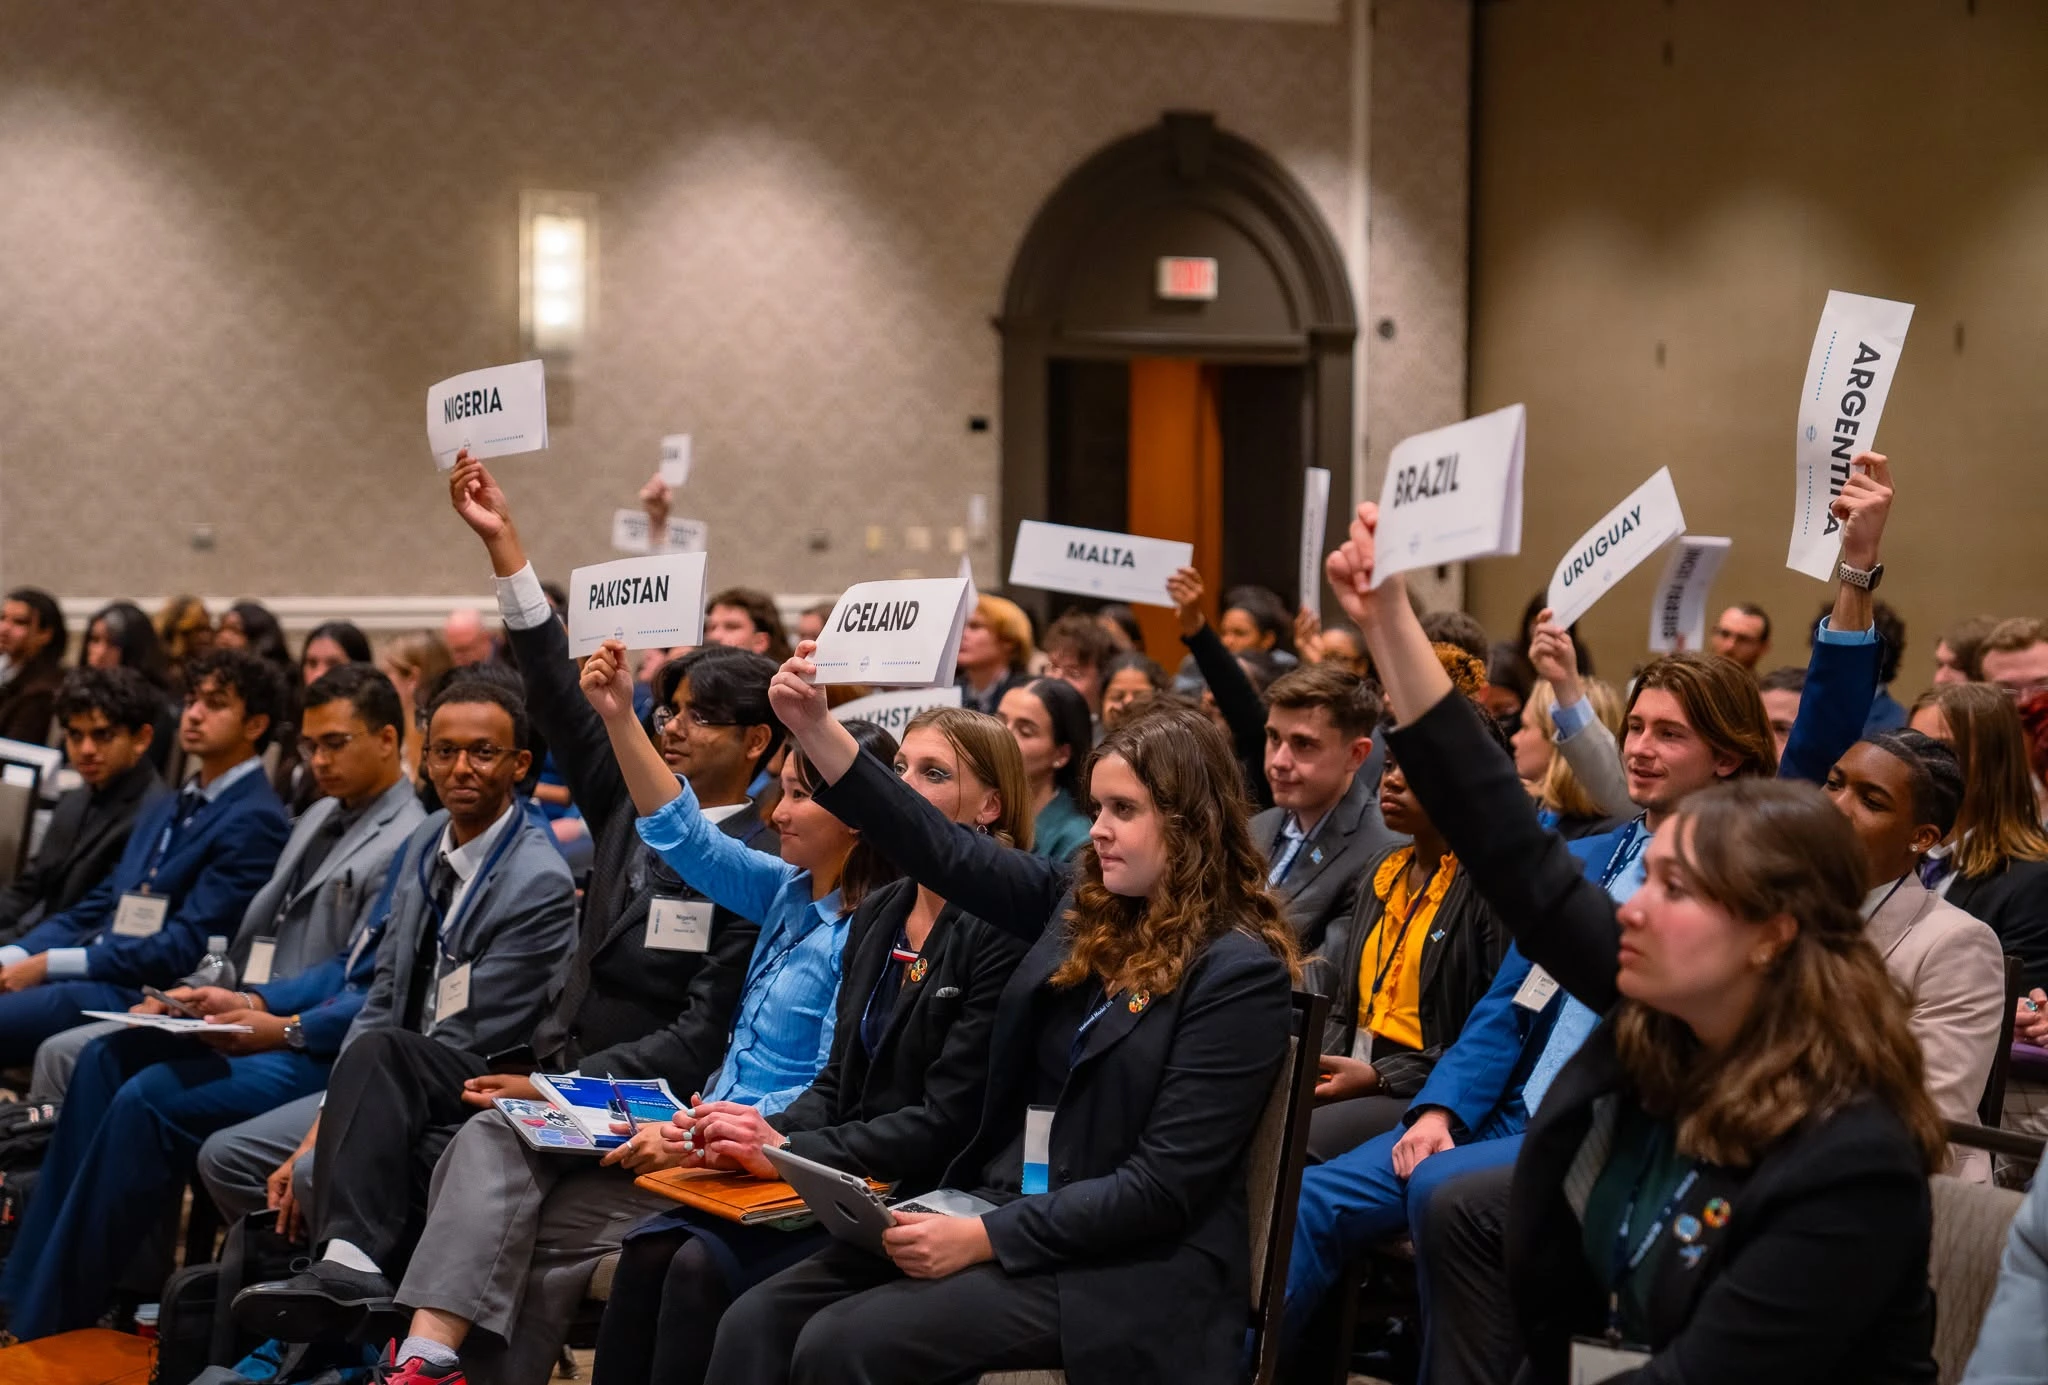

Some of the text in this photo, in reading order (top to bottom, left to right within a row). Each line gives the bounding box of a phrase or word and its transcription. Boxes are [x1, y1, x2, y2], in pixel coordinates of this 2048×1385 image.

[444, 387, 502, 424] NIGERIA
[1823, 341, 1881, 535] ARGENTIA
[1394, 453, 1459, 508] BRAZIL
[1066, 541, 1135, 568] MALTA
[1563, 504, 1641, 587] URUGUAY
[589, 575, 669, 610] PAKISTAN
[837, 601, 919, 632] ICELAND
